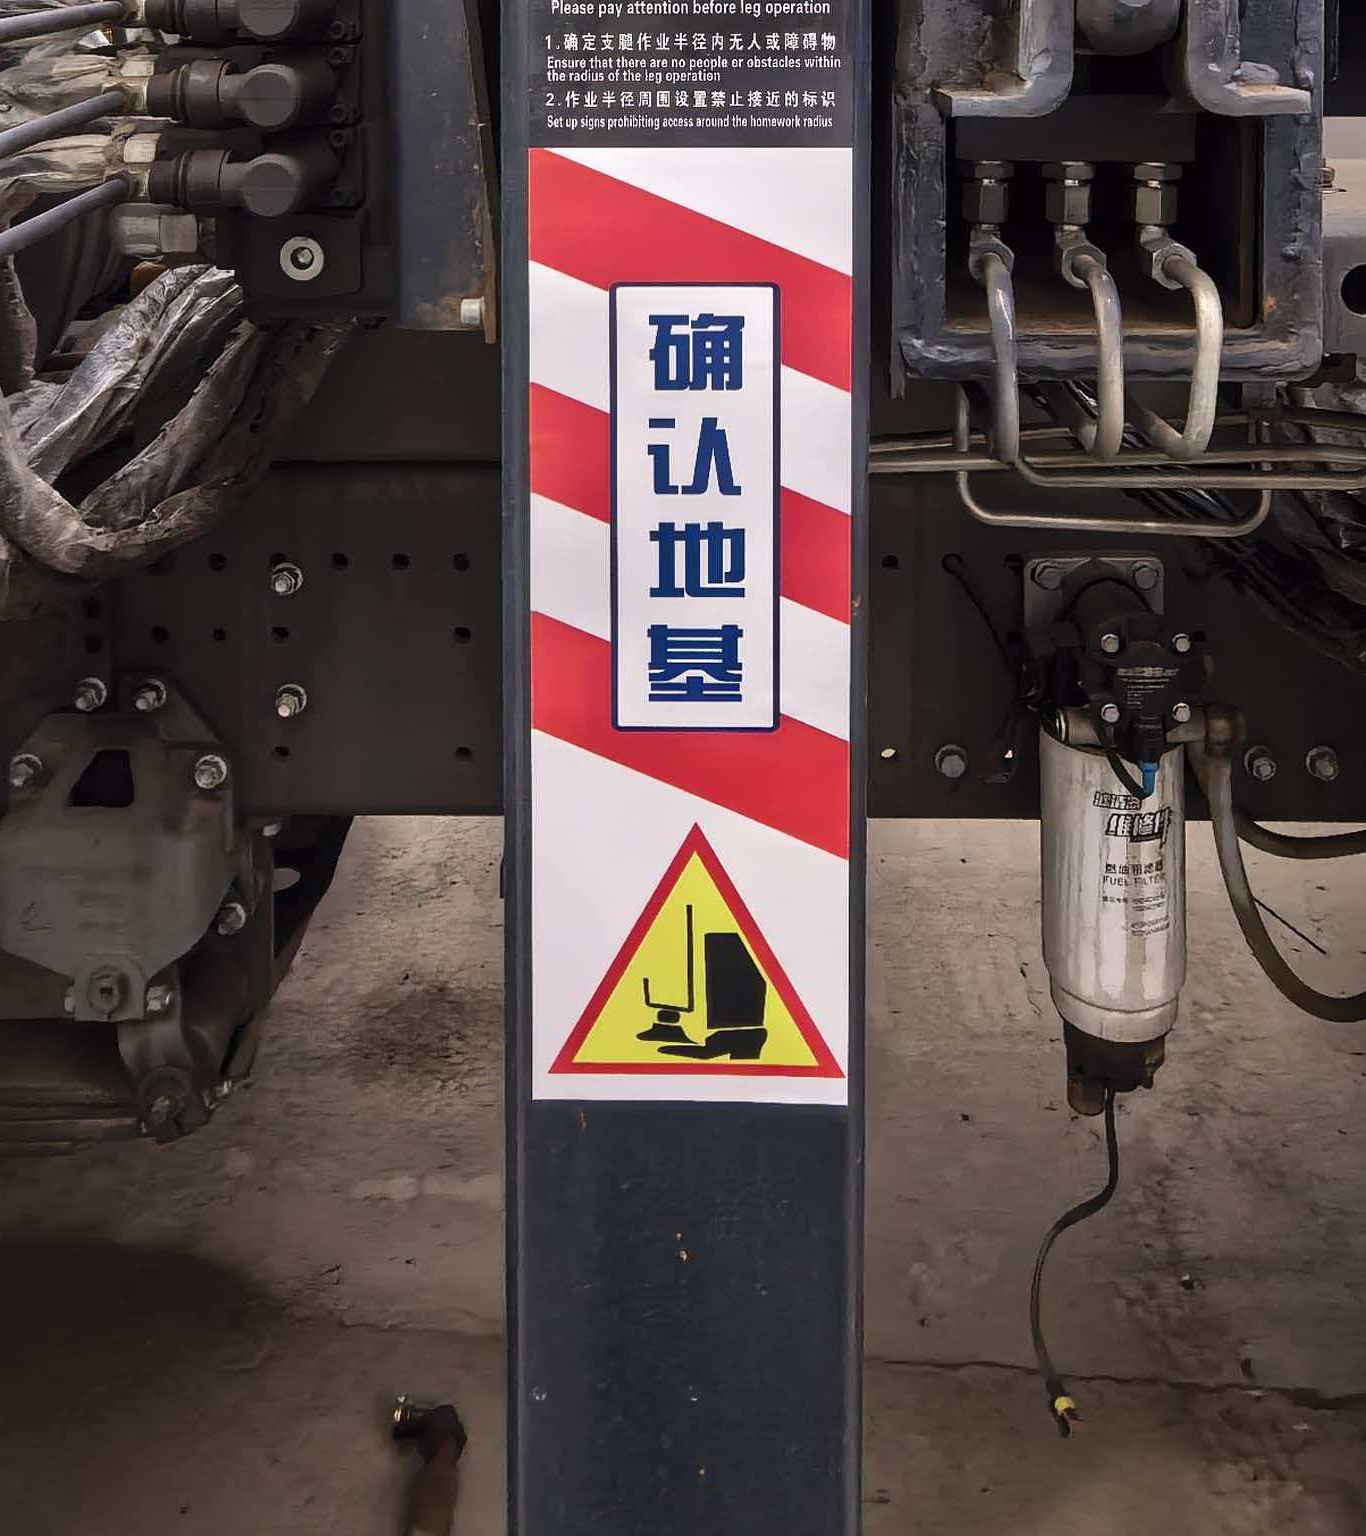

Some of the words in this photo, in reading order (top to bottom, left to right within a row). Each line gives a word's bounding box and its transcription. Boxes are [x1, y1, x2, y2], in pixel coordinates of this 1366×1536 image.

[551, 0, 595, 15] Please
[598, 2, 623, 18] pay
[627, 0, 689, 15] attention
[547, 56, 587, 69] Ensure
[589, 56, 613, 69] that
[616, 56, 647, 69] there
[650, 58, 668, 69] are
[671, 58, 686, 69] no
[689, 56, 728, 71] people
[746, 56, 801, 68] obstacles
[804, 55, 842, 68] within
[547, 69, 566, 82] the
[568, 69, 605, 82] radius
[608, 69, 621, 82] of
[622, 69, 642, 82] the
[645, 69, 662, 84] leg
[665, 69, 722, 84] operation
[547, 115, 563, 128] Set
[565, 117, 578, 130] up
[580, 115, 605, 131] signs
[607, 115, 660, 131] prohibiting
[696, 115, 730, 128] around
[732, 115, 748, 127] the
[750, 114, 802, 128] homework
[648, 312, 746, 704] 确认地基
